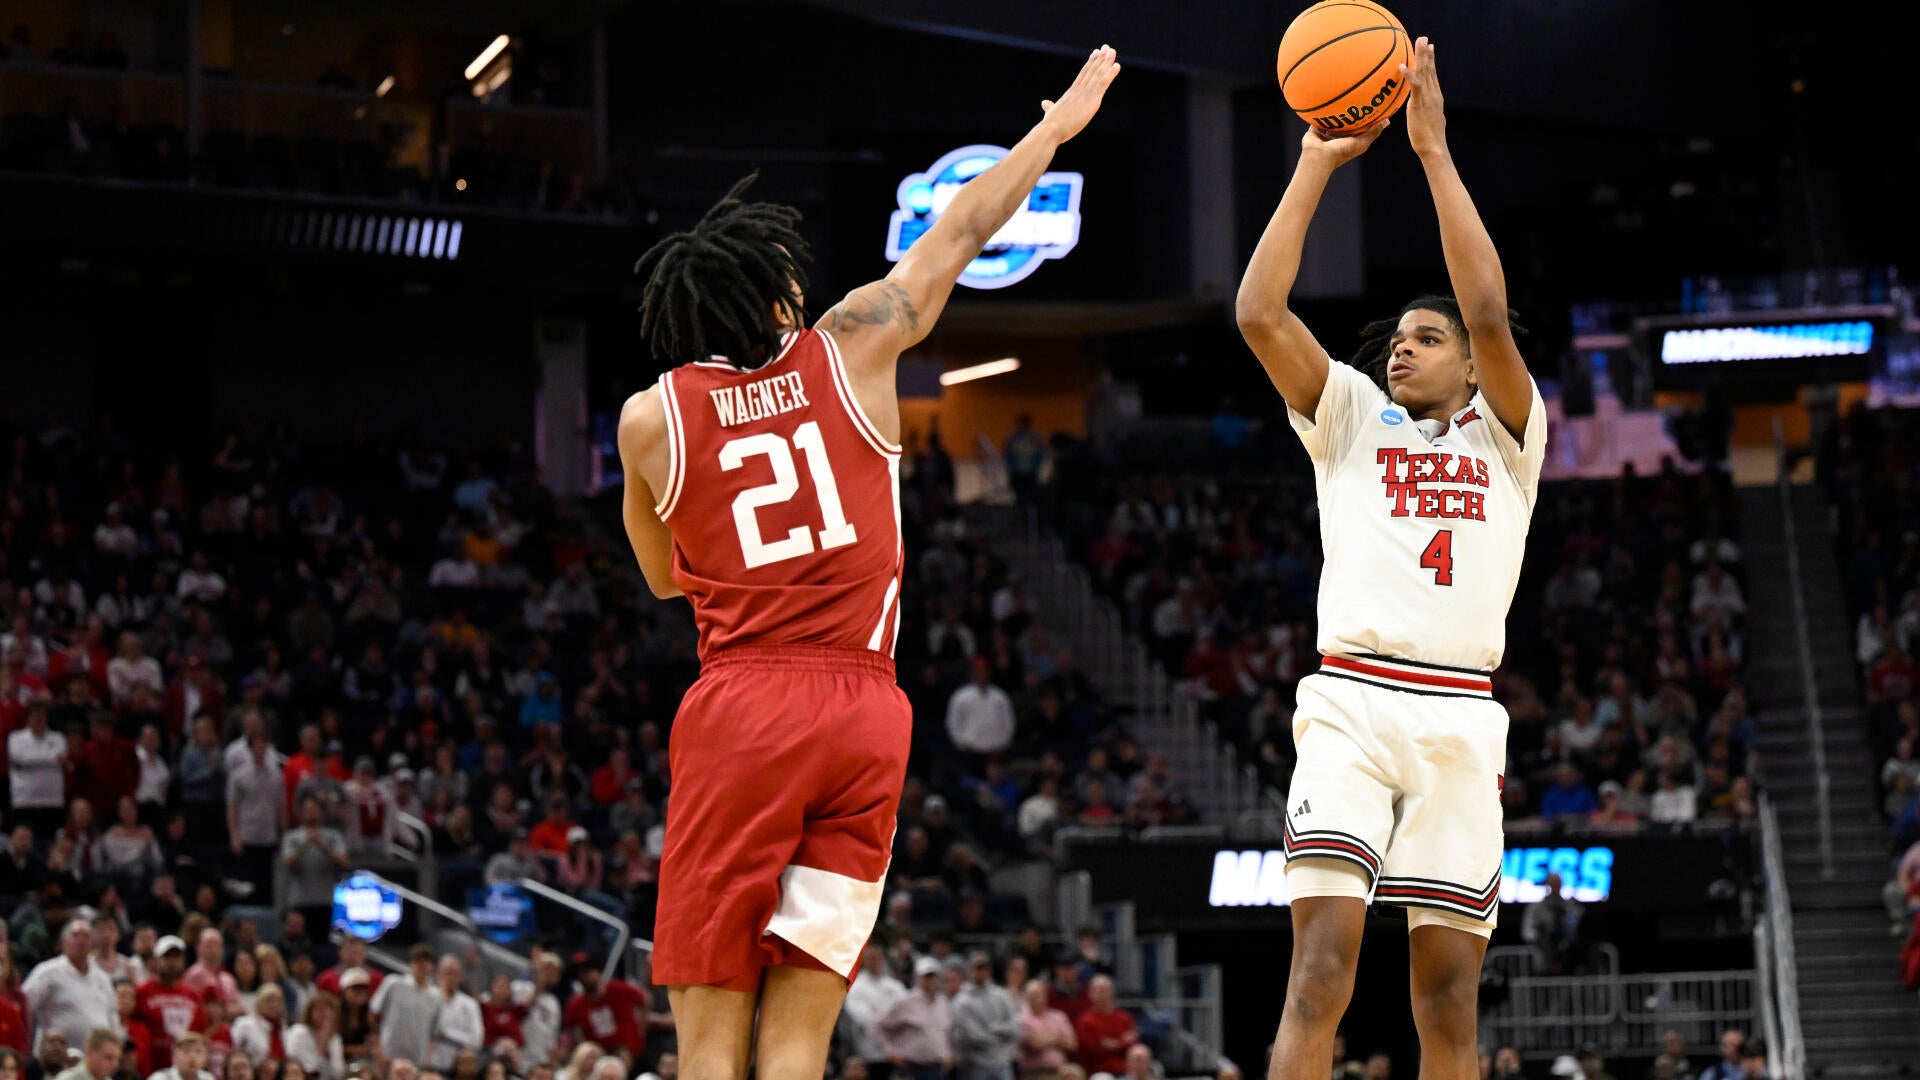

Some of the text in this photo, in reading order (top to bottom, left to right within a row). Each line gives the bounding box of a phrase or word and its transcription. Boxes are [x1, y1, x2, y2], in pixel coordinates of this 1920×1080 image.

[1312, 78, 1398, 129] Wilson
[710, 371, 810, 428] WAGNER
[718, 420, 858, 570] 21
[1376, 447, 1490, 489] TEXAS
[1386, 482, 1486, 522] TECH
[1420, 529, 1453, 586] 4
[1500, 847, 1614, 903] NESS
